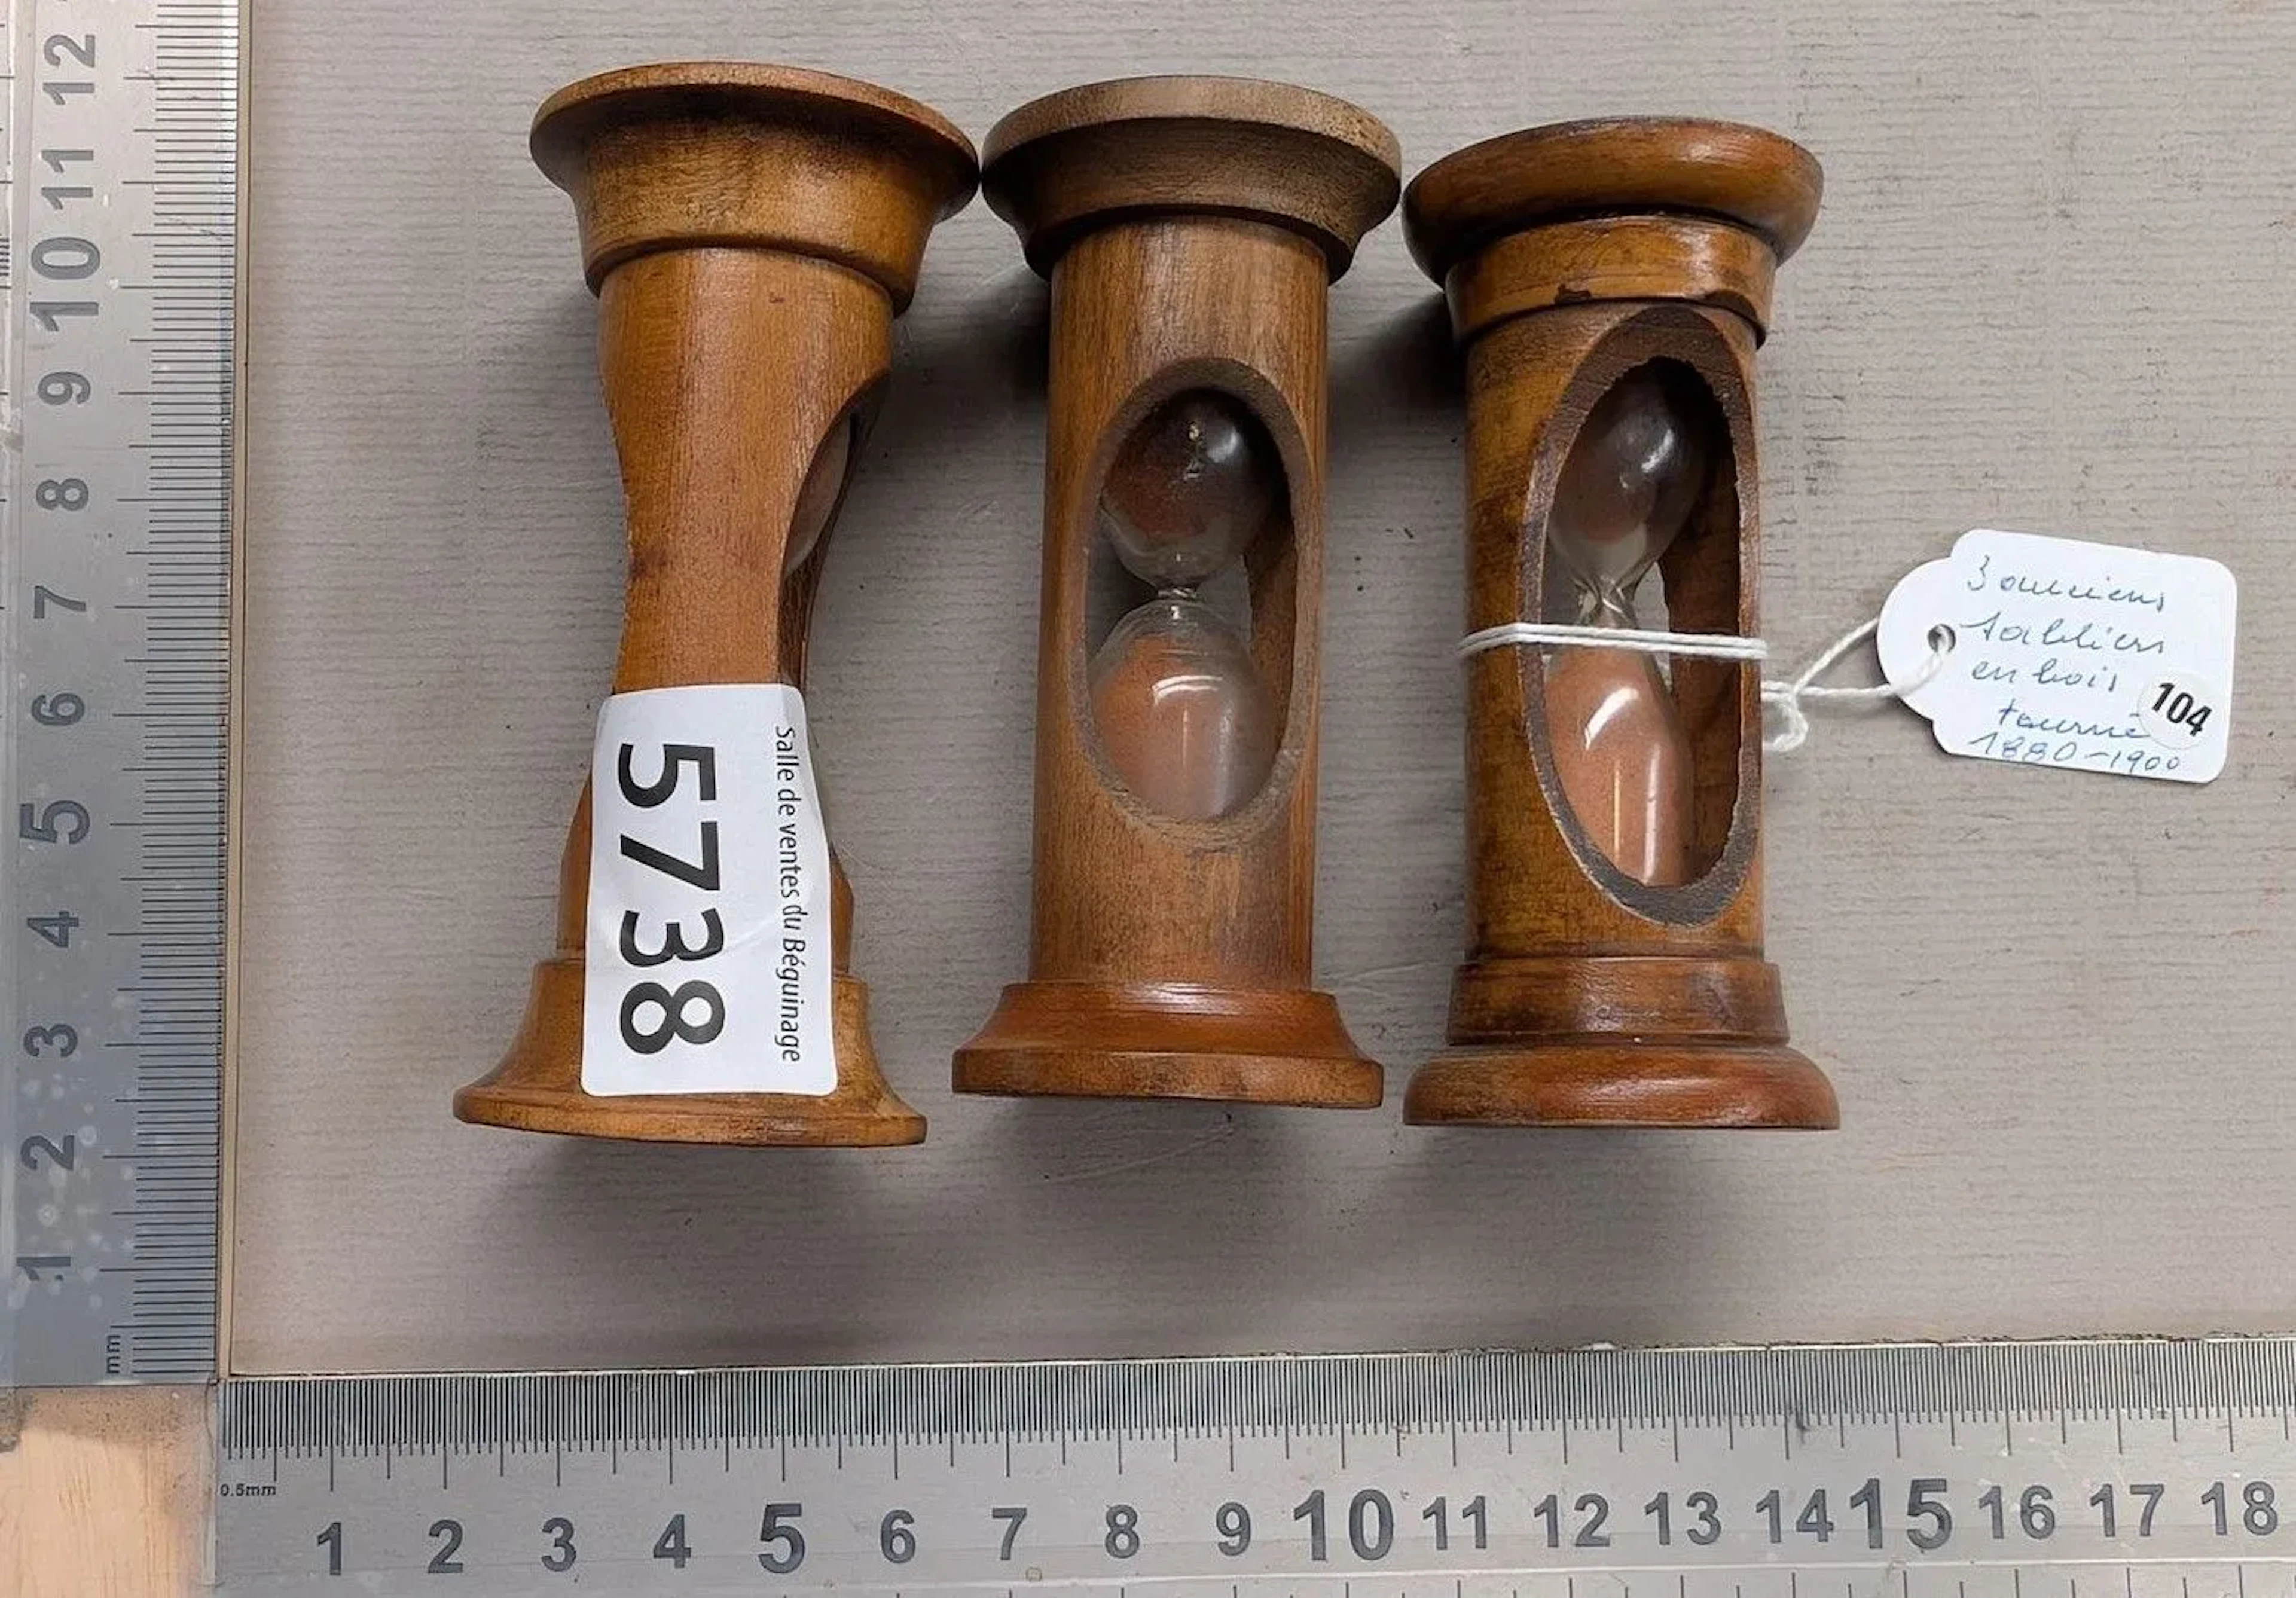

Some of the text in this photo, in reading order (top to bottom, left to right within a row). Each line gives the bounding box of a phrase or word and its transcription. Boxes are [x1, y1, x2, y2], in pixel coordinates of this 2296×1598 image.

[1968, 555, 1990, 590] 3
[17, 35, 100, 1281] 1 2 3 4 5 6 7 8 9 10 11 12
[1972, 658, 2117, 692] en bois
[2151, 682, 2213, 737] 104
[618, 743, 725, 1055] 5738
[776, 727, 808, 1062] Salle de ventes du Béguinage
[107, 1335, 120, 1373] mm
[221, 1483, 277, 1497] 0.5mm
[316, 1478, 2278, 1575] 1 2 3 4 5 6 7 8 9 10 11 12 13 14 15 16 17 18
